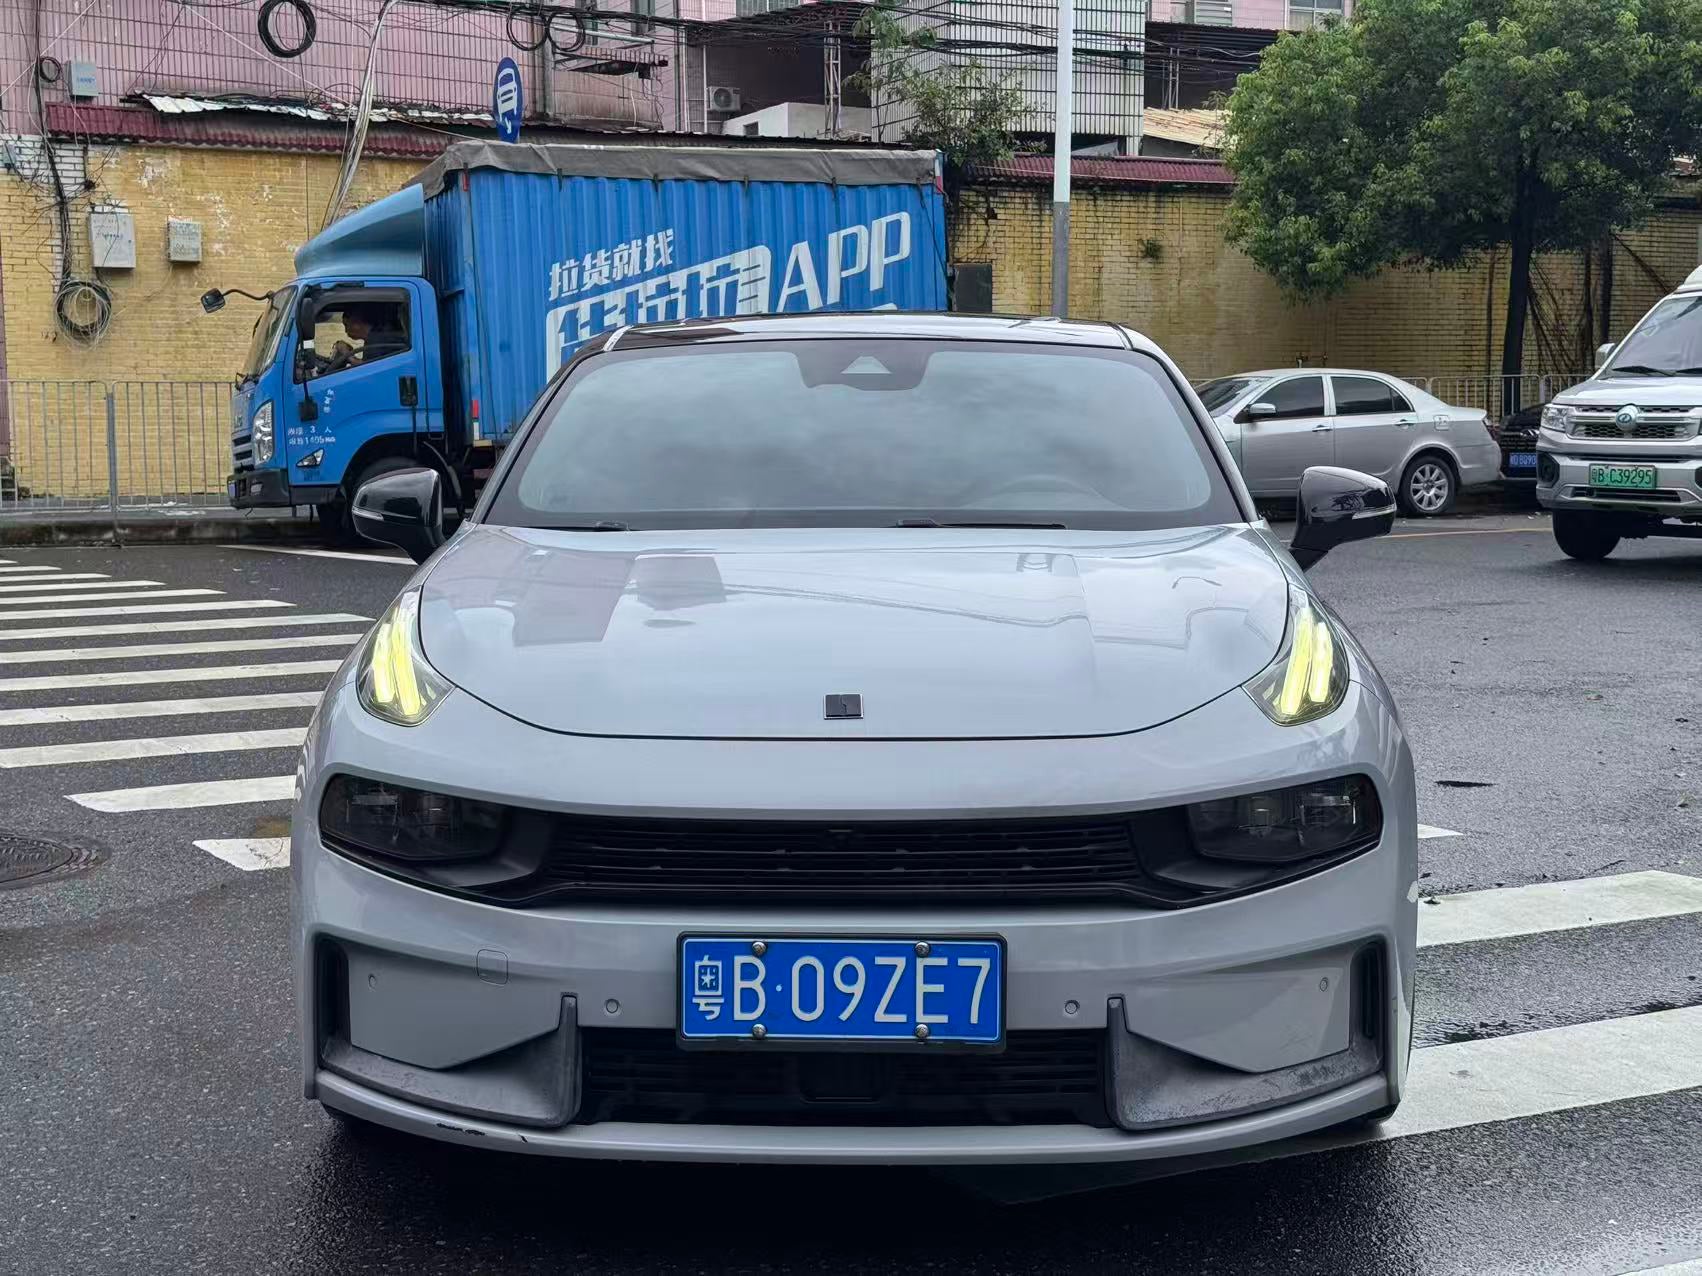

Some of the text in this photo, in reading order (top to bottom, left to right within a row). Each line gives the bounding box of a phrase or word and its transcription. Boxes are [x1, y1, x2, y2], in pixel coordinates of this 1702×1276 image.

[549, 228, 674, 301] 拉货就找
[776, 211, 911, 313] APP
